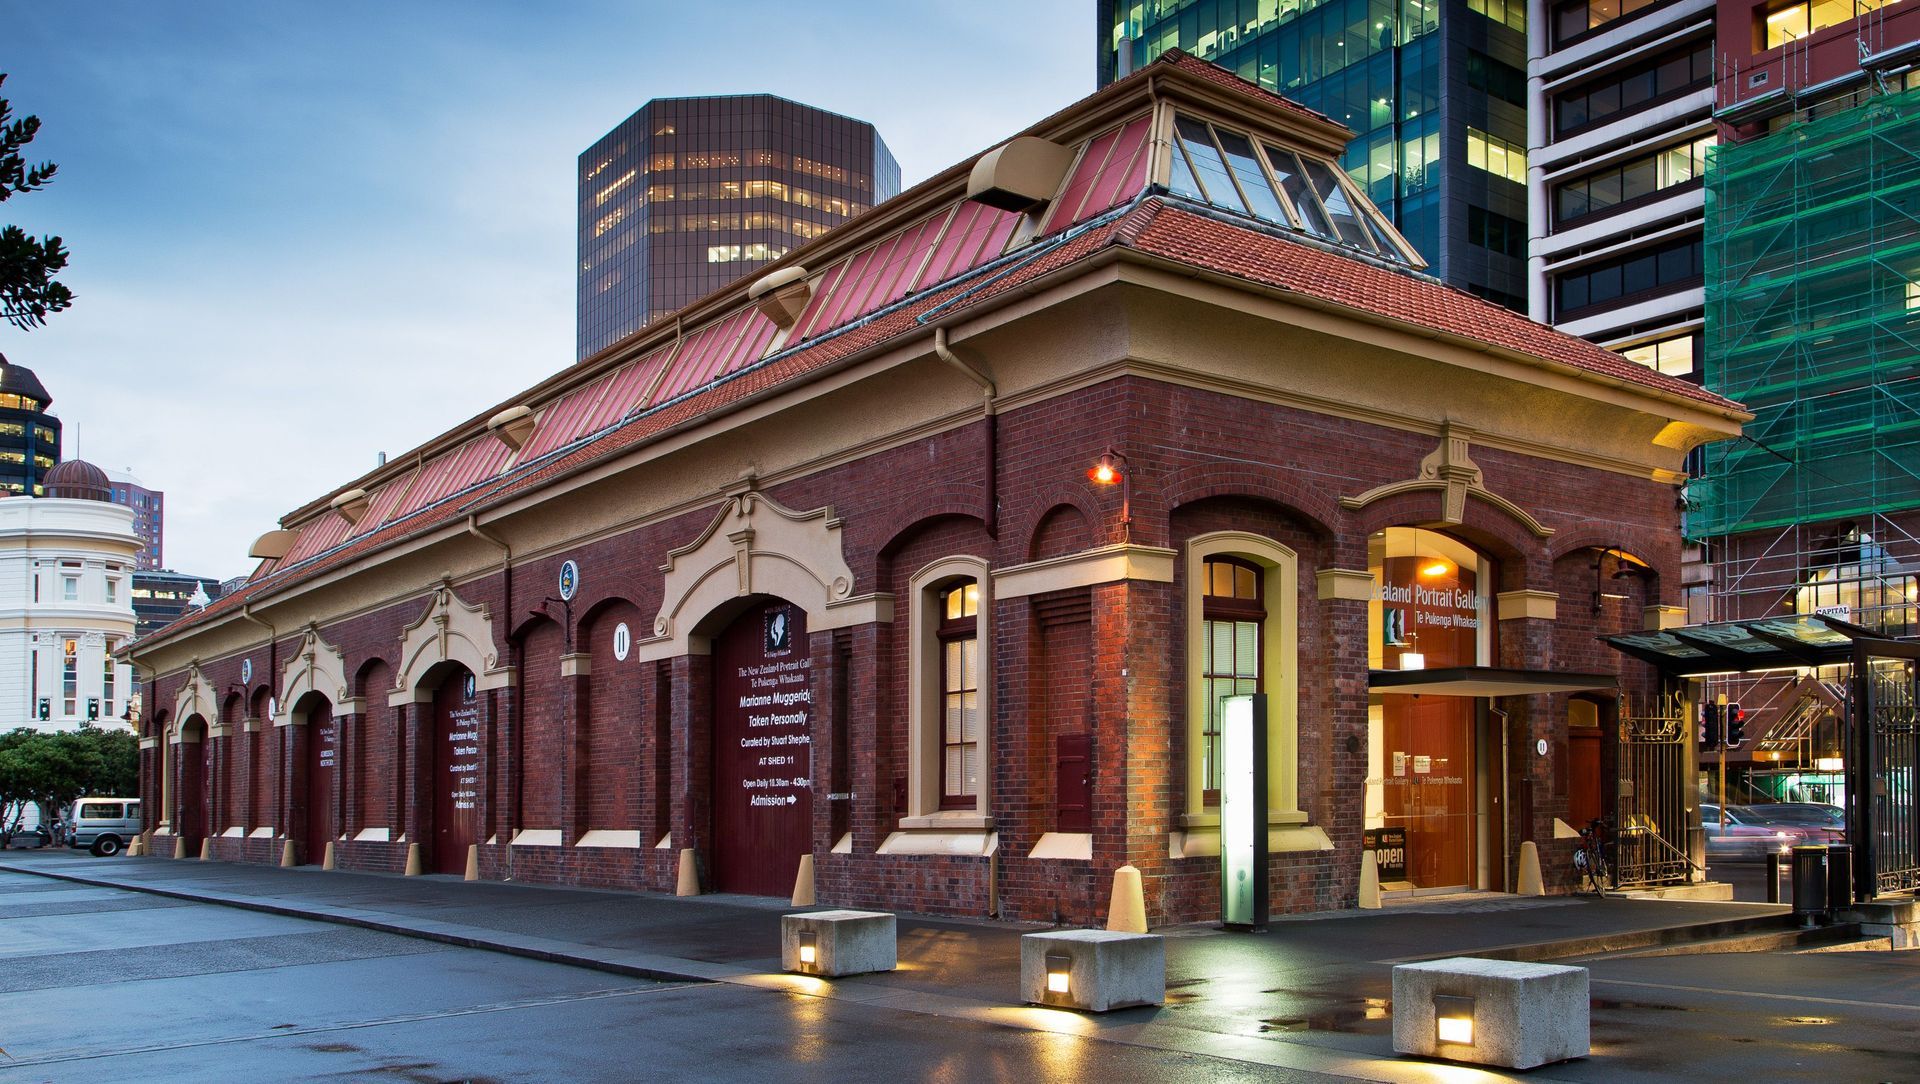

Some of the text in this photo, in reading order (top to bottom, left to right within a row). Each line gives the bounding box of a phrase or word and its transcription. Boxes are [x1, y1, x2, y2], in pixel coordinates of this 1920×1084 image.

[1416, 584, 1453, 608] Portrait
[1816, 607, 1849, 616] CAPITAL
[1416, 610, 1424, 624] Te
[1425, 612, 1451, 628] Pukenga
[738, 667, 747, 677] The
[748, 666, 759, 676] New
[760, 662, 779, 674] Zealand
[740, 694, 771, 708] Marianne
[748, 710, 808, 728] Taken Personally
[740, 737, 763, 748] Curated
[763, 736, 771, 748] by
[771, 735, 787, 746] Stuart
[759, 755, 794, 766] AT SHED 11
[743, 779, 756, 789] Open
[756, 778, 769, 789] Daily
[750, 794, 786, 806] Admission
[1377, 848, 1404, 868] open
